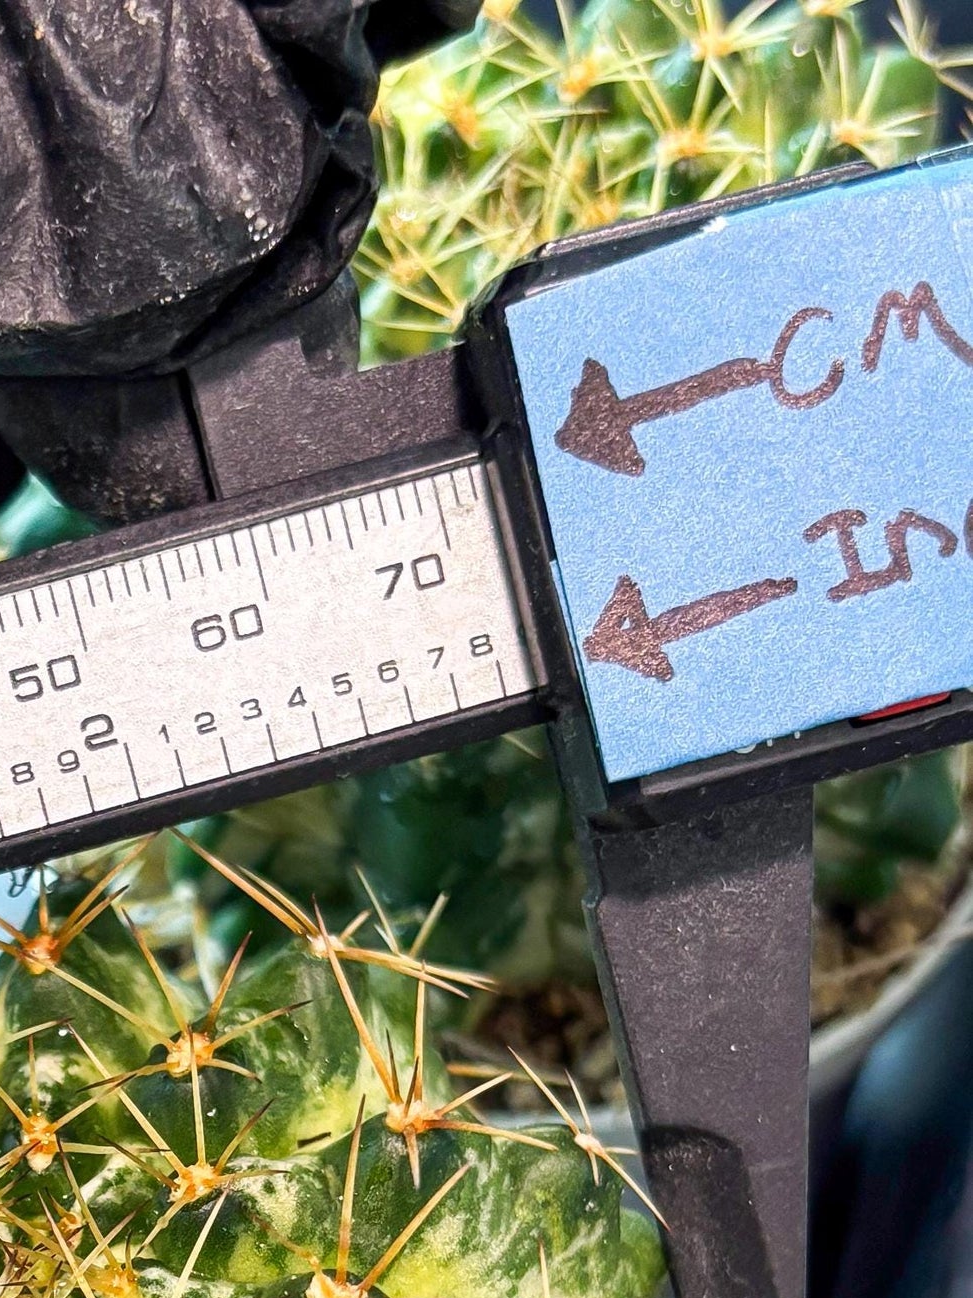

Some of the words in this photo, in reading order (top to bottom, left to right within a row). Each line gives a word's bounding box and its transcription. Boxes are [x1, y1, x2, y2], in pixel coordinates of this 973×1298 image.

[8, 654, 82, 703] 50
[190, 603, 264, 652] 60
[375, 553, 446, 599] 70
[802, 507, 973, 602] In
[10, 761, 35, 785] 8
[57, 749, 81, 774] 9
[80, 713, 118, 751] 2
[158, 724, 170, 744] 1
[194, 711, 217, 735] 2
[240, 698, 263, 721] 3
[287, 685, 307, 708] 4
[331, 672, 353, 696] 5
[377, 659, 400, 683] 6
[427, 646, 445, 669] 7
[469, 633, 494, 657] 8
